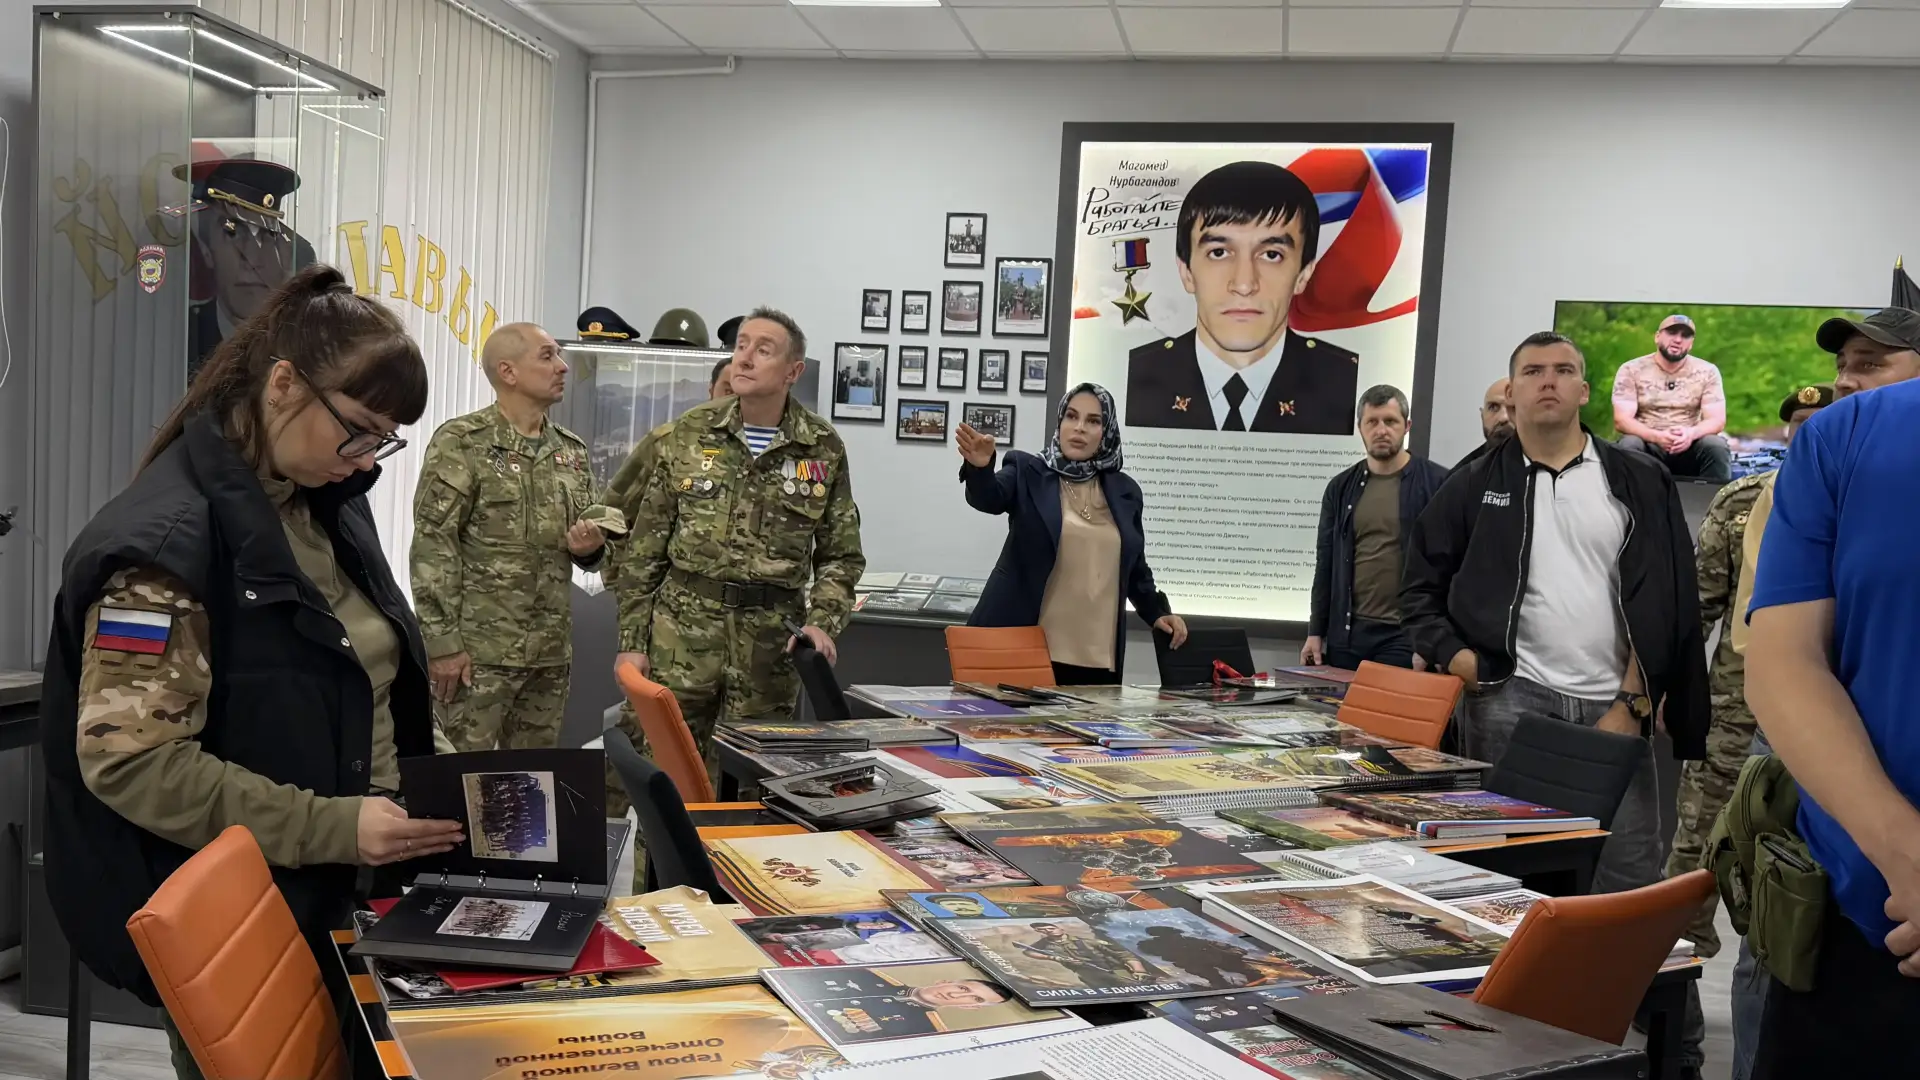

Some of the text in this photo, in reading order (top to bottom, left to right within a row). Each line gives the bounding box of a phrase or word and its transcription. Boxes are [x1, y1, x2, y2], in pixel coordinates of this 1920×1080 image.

[1118, 159, 1169, 171] Магомед
[1109, 175, 1180, 189] Нурбагандов
[1036, 989, 1082, 997] СИЛА
[1099, 982, 1183, 995] ЕДИНСТВЕ
[558, 1031, 646, 1045] Войны
[495, 1037, 725, 1067] Отечественной
[648, 1053, 723, 1068] Герои
